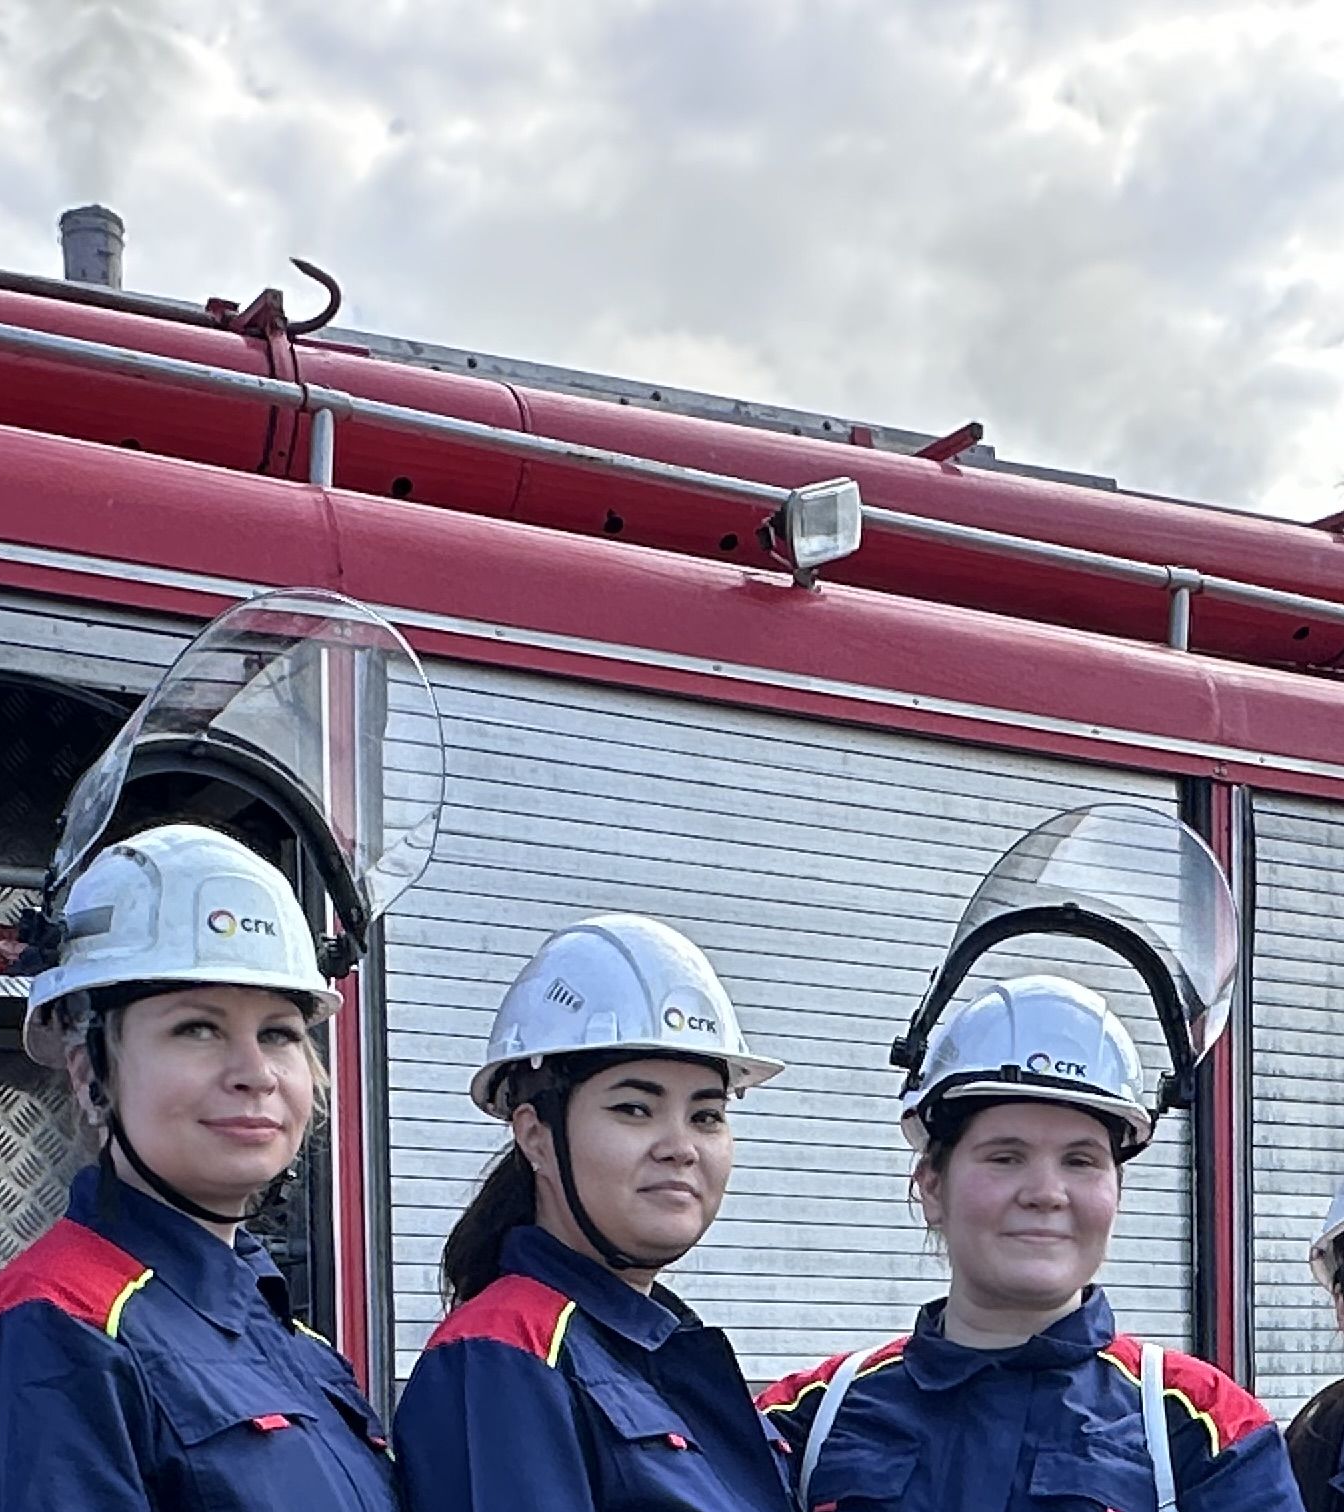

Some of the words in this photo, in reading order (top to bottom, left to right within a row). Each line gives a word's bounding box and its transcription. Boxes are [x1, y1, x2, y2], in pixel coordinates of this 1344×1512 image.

[240, 917, 277, 937] СГК
[687, 1016, 717, 1034] СГК
[1055, 1060, 1087, 1078] СГК
